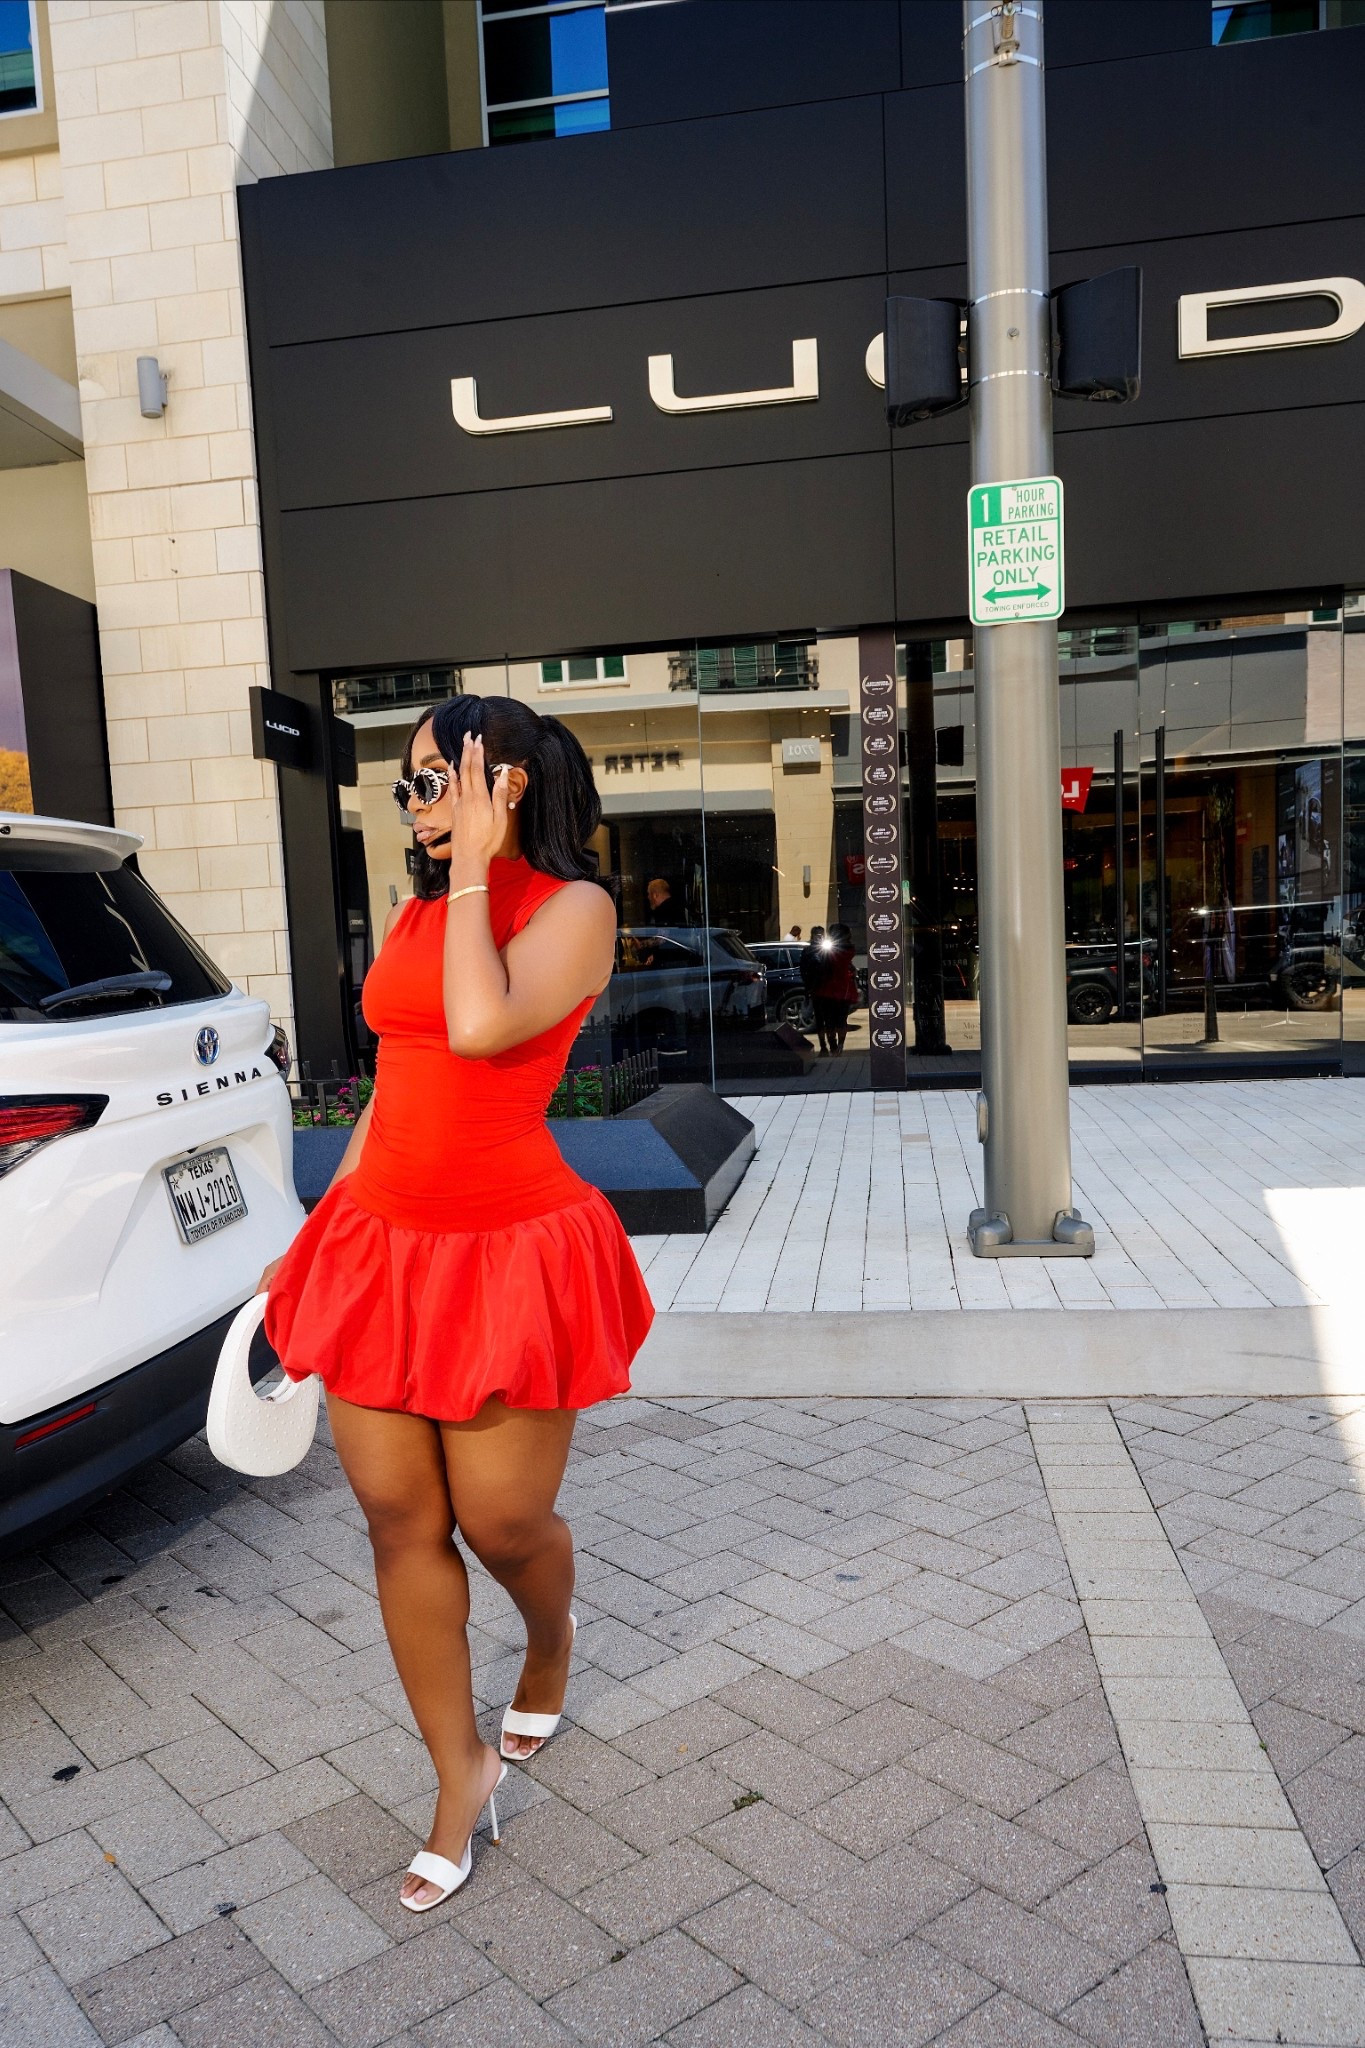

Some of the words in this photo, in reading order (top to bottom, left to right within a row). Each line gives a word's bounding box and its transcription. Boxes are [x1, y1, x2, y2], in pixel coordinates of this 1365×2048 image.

[1016, 487, 1045, 503] HOUR
[981, 493, 989, 523] 1
[1008, 502, 1054, 519] PARKING
[983, 525, 1049, 547] RETAIL
[977, 544, 1055, 567] PARKING
[993, 566, 1039, 585] ONLY
[985, 604, 1011, 613] TOWING
[1012, 601, 1050, 611] ENFORCED
[266, 720, 300, 736] LUCID
[156, 1067, 262, 1106] SIENNA
[188, 1160, 214, 1180] TEXAS
[190, 1223, 212, 1239] TOYOTA
[210, 1219, 219, 1231] OF
